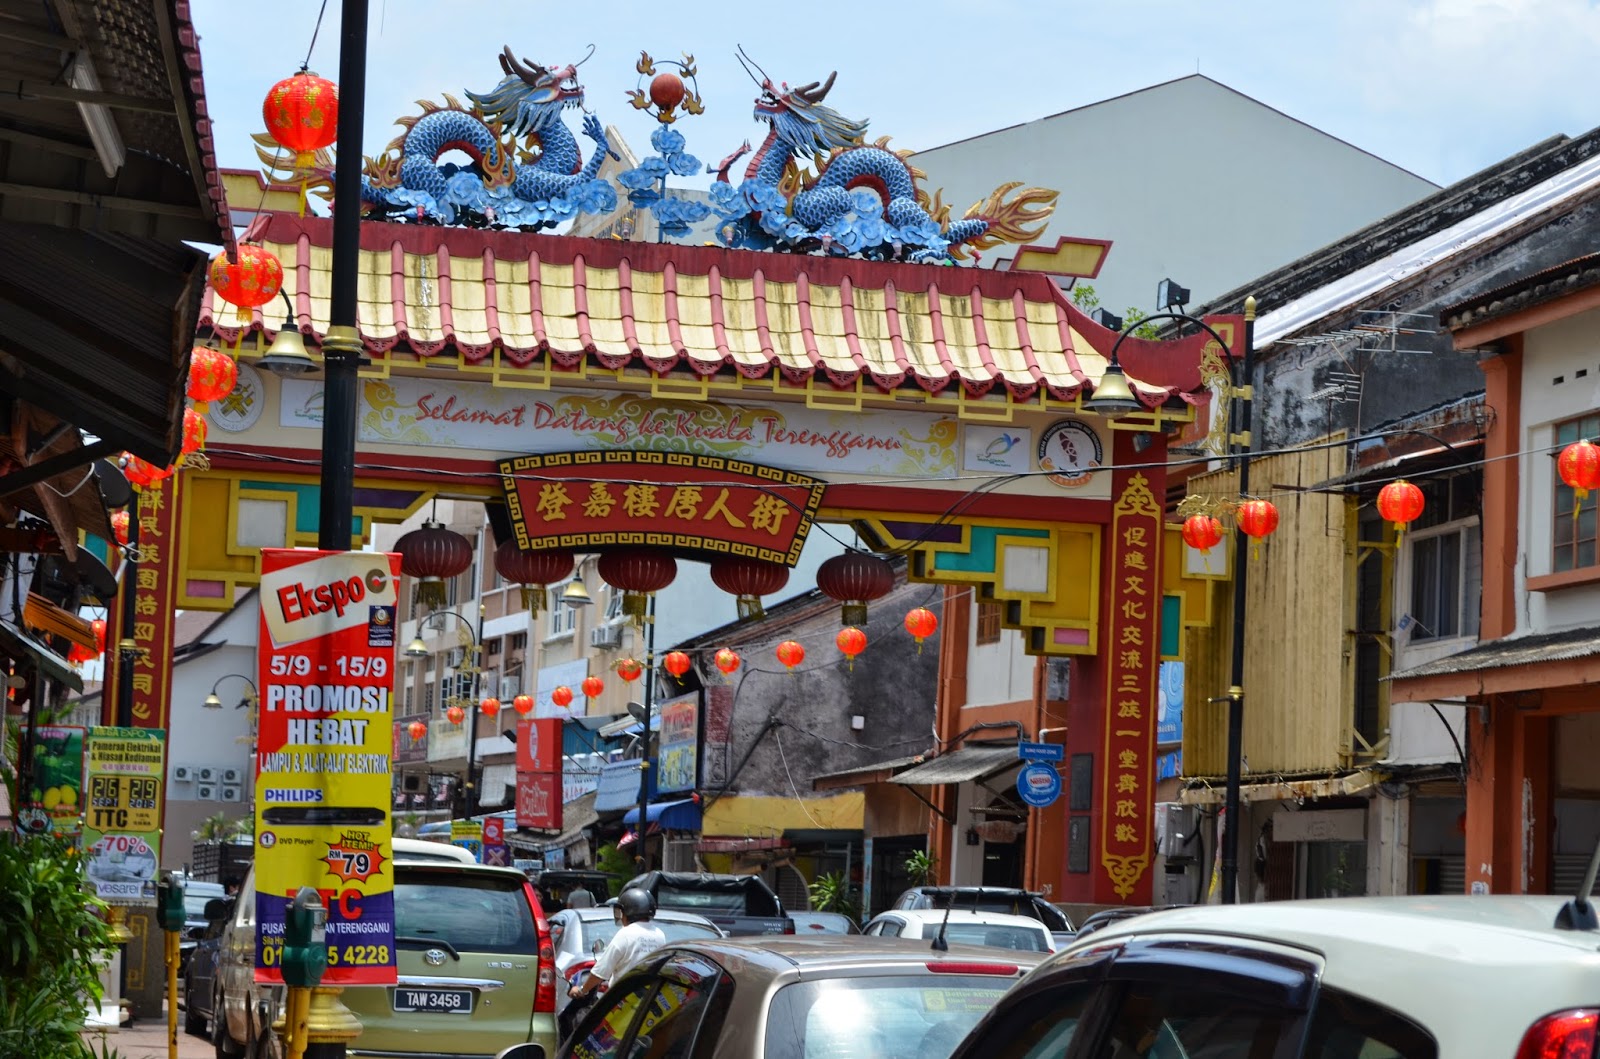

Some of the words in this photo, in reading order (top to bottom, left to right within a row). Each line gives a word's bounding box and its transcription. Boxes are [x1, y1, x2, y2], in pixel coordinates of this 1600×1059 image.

[416, 393, 526, 428] Selamat
[534, 401, 629, 444] Datang
[637, 410, 665, 435] ke
[674, 411, 755, 442] Kuala
[761, 416, 903, 458] Terengganu
[277, 575, 366, 624] Ekspo
[270, 655, 311, 676] 5/9
[336, 656, 387, 678] 15/9
[267, 684, 390, 713] PROMOSI
[120, 730, 146, 738] EXPO
[287, 718, 369, 746] HEBAT
[260, 752, 292, 773] LAMPU
[294, 753, 302, 773] &
[348, 753, 390, 775] ELEKTRIK
[93, 779, 119, 798] 26
[130, 780, 155, 799] 29
[265, 789, 323, 802] PHILIPS
[128, 800, 156, 809] 2013
[93, 809, 128, 828] TTC
[96, 836, 148, 854] -70%
[294, 838, 315, 846] Player
[341, 839, 374, 851] ITEM!!
[347, 830, 370, 841] HOT
[328, 850, 341, 859] RM
[342, 852, 369, 874] 79
[261, 923, 286, 934] PUSA
[336, 922, 390, 934] TERENGGANU
[343, 945, 390, 965] 4228
[406, 992, 428, 1006] TAW
[429, 993, 461, 1008] 3458
